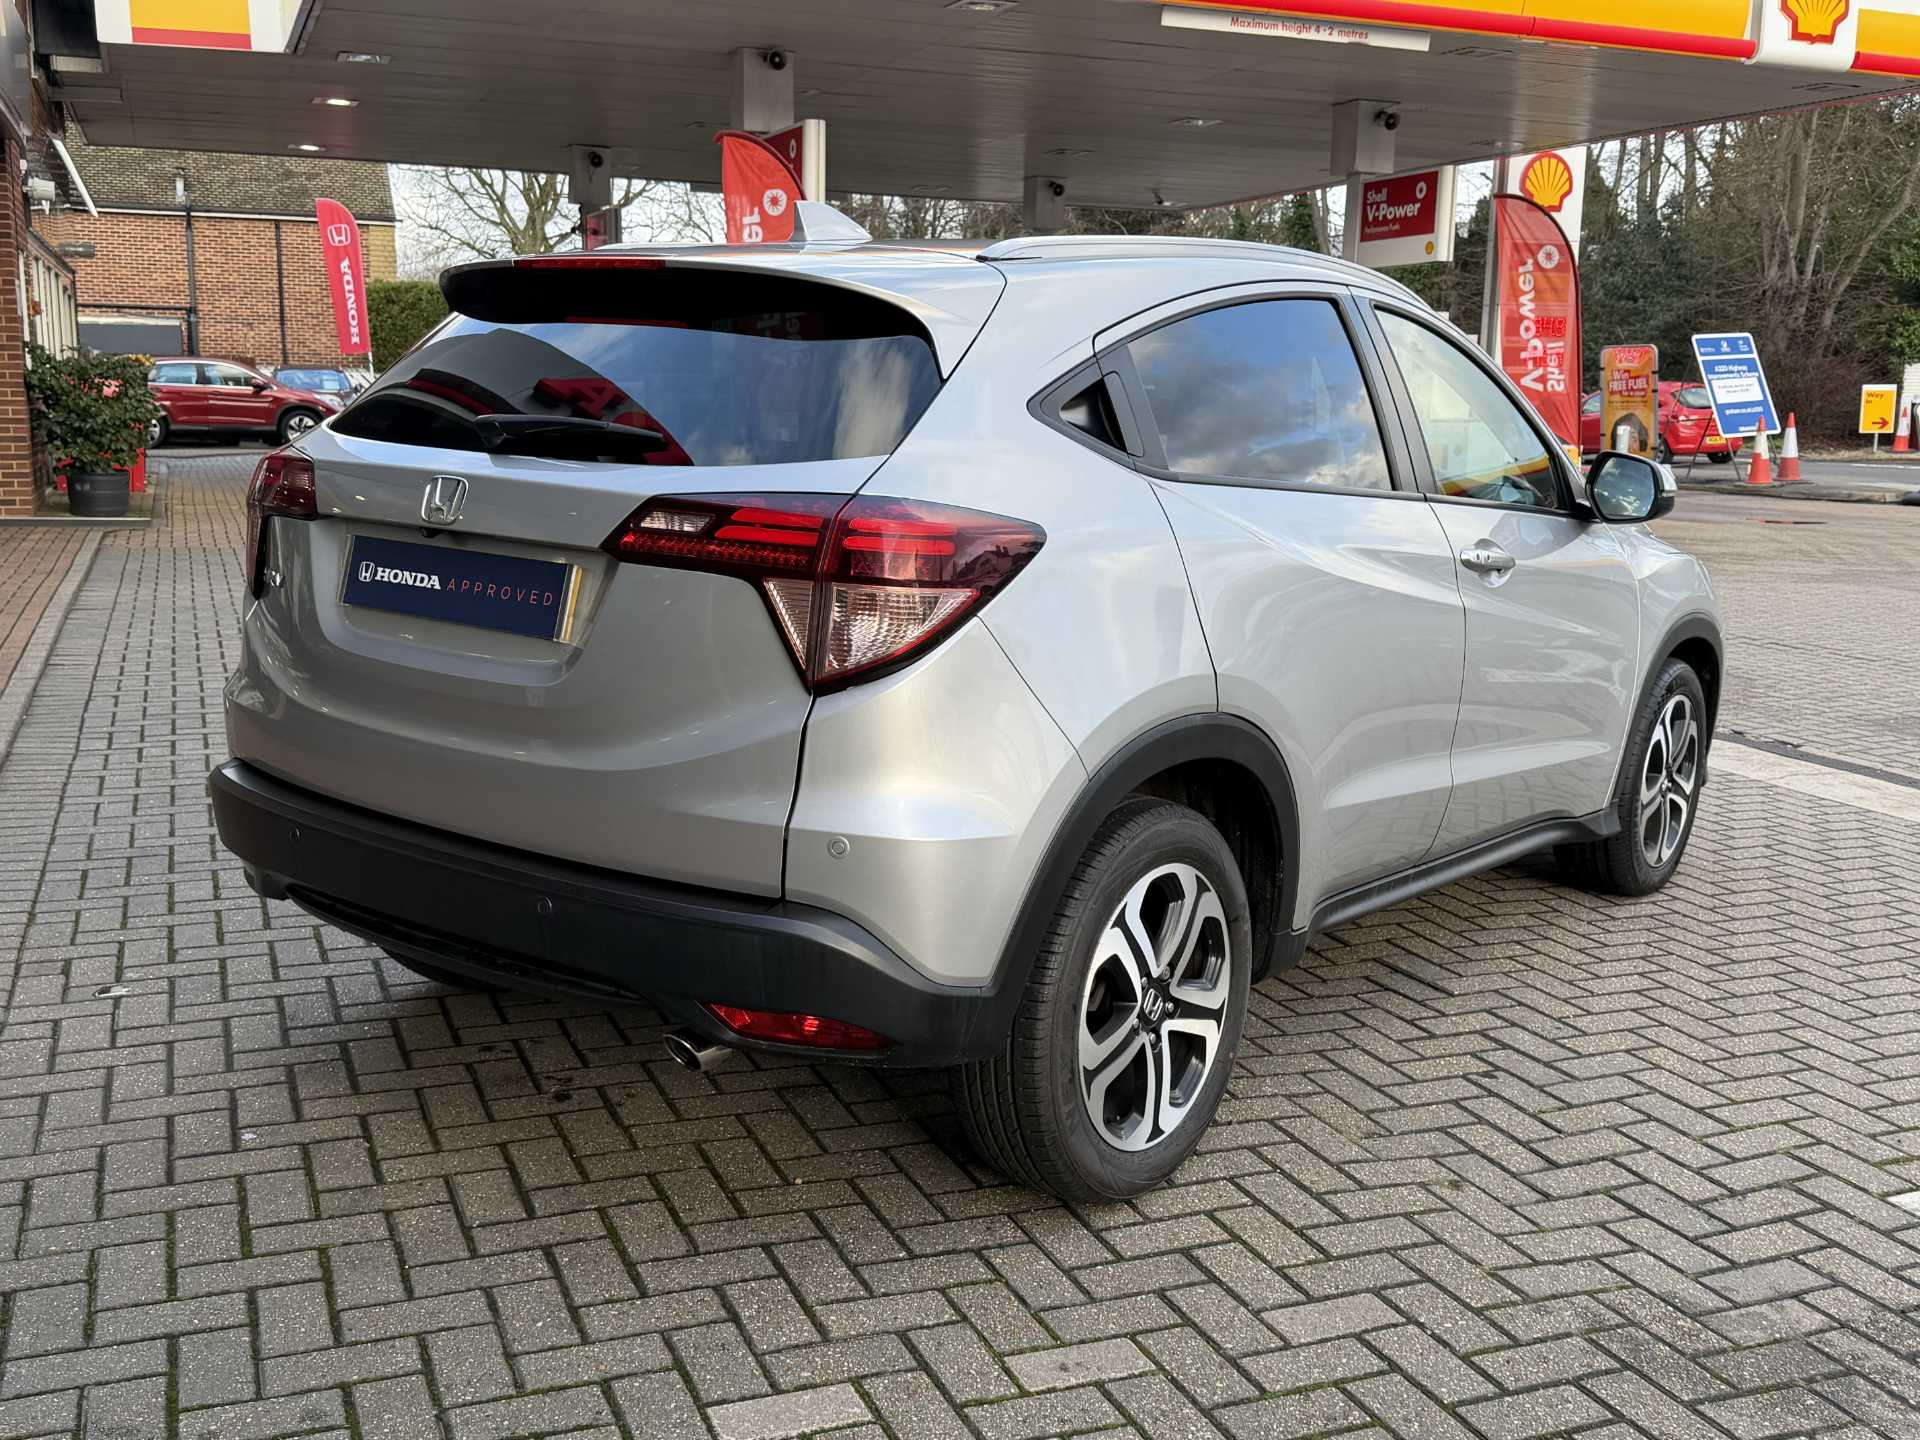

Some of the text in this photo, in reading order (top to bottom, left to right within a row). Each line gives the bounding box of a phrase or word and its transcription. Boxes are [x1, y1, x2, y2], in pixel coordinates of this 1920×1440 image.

[1230, 16, 1279, 31] Maximum
[1281, 20, 1312, 35] height
[1337, 29, 1369, 40] metres
[1366, 187, 1388, 204] Shell
[340, 256, 361, 345] HONDA
[1612, 369, 1630, 380] Win
[1609, 377, 1649, 393] FREE FUEL
[375, 566, 441, 590] HONDA
[447, 578, 553, 606] APPROVED
